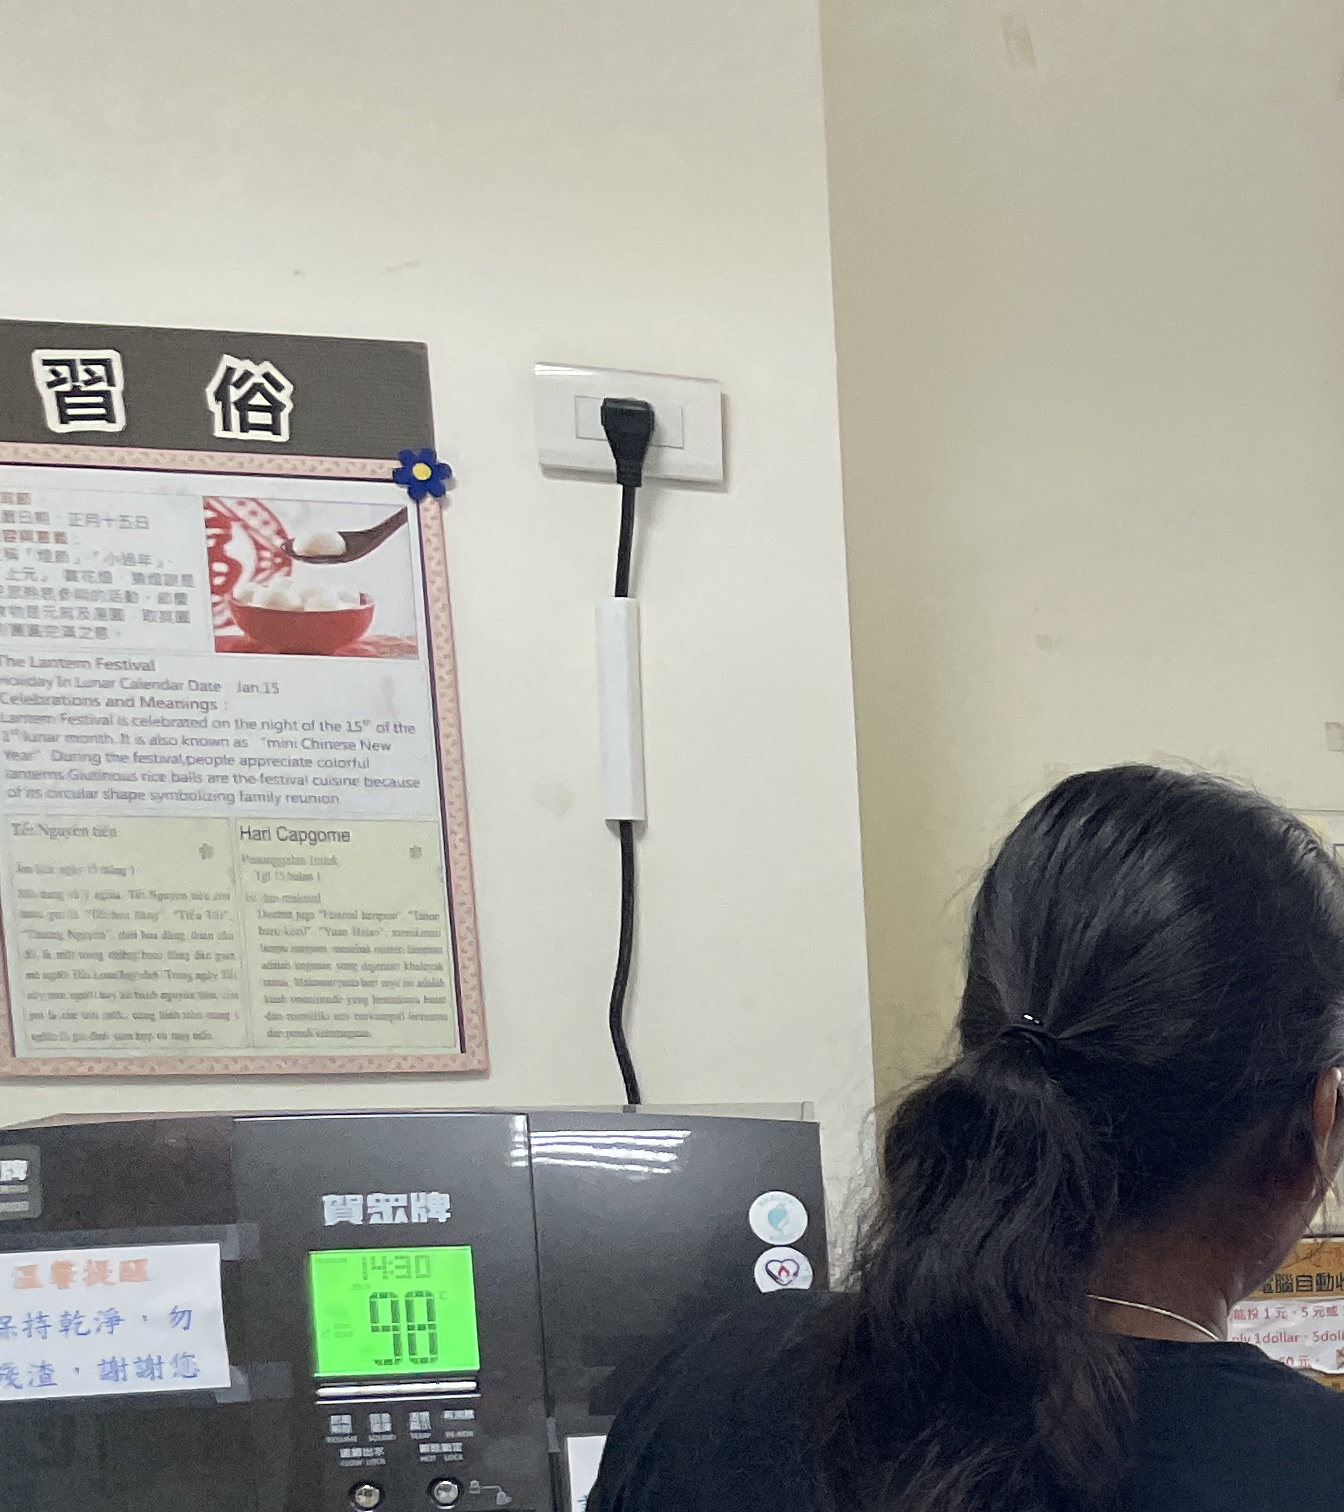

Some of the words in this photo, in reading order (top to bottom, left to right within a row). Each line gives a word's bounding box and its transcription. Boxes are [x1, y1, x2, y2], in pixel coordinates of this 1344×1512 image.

[96, 657, 156, 671] Festival
[188, 679, 221, 692] Date
[105, 696, 135, 708] and
[132, 713, 208, 729] celebrated
[212, 721, 230, 729] on
[234, 718, 257, 730] the
[261, 719, 298, 733] night
[302, 719, 314, 731] of
[319, 720, 341, 732] the
[376, 722, 389, 734] of
[393, 722, 415, 734] the
[149, 733, 178, 746] also
[182, 734, 229, 747] known
[233, 739, 249, 748] as
[301, 737, 356, 750] Chinese
[360, 740, 391, 751] New
[240, 757, 312, 769] appreciate
[317, 757, 369, 769] colorful
[207, 774, 228, 784] are
[232, 773, 257, 785] the
[260, 773, 308, 786] festival
[364, 776, 420, 788] because
[104, 788, 146, 803] shape
[240, 825, 271, 841] Hari
[276, 826, 351, 846] Capgome
[361, 1255, 432, 1280] 14:30
[369, 1290, 439, 1366] 98
